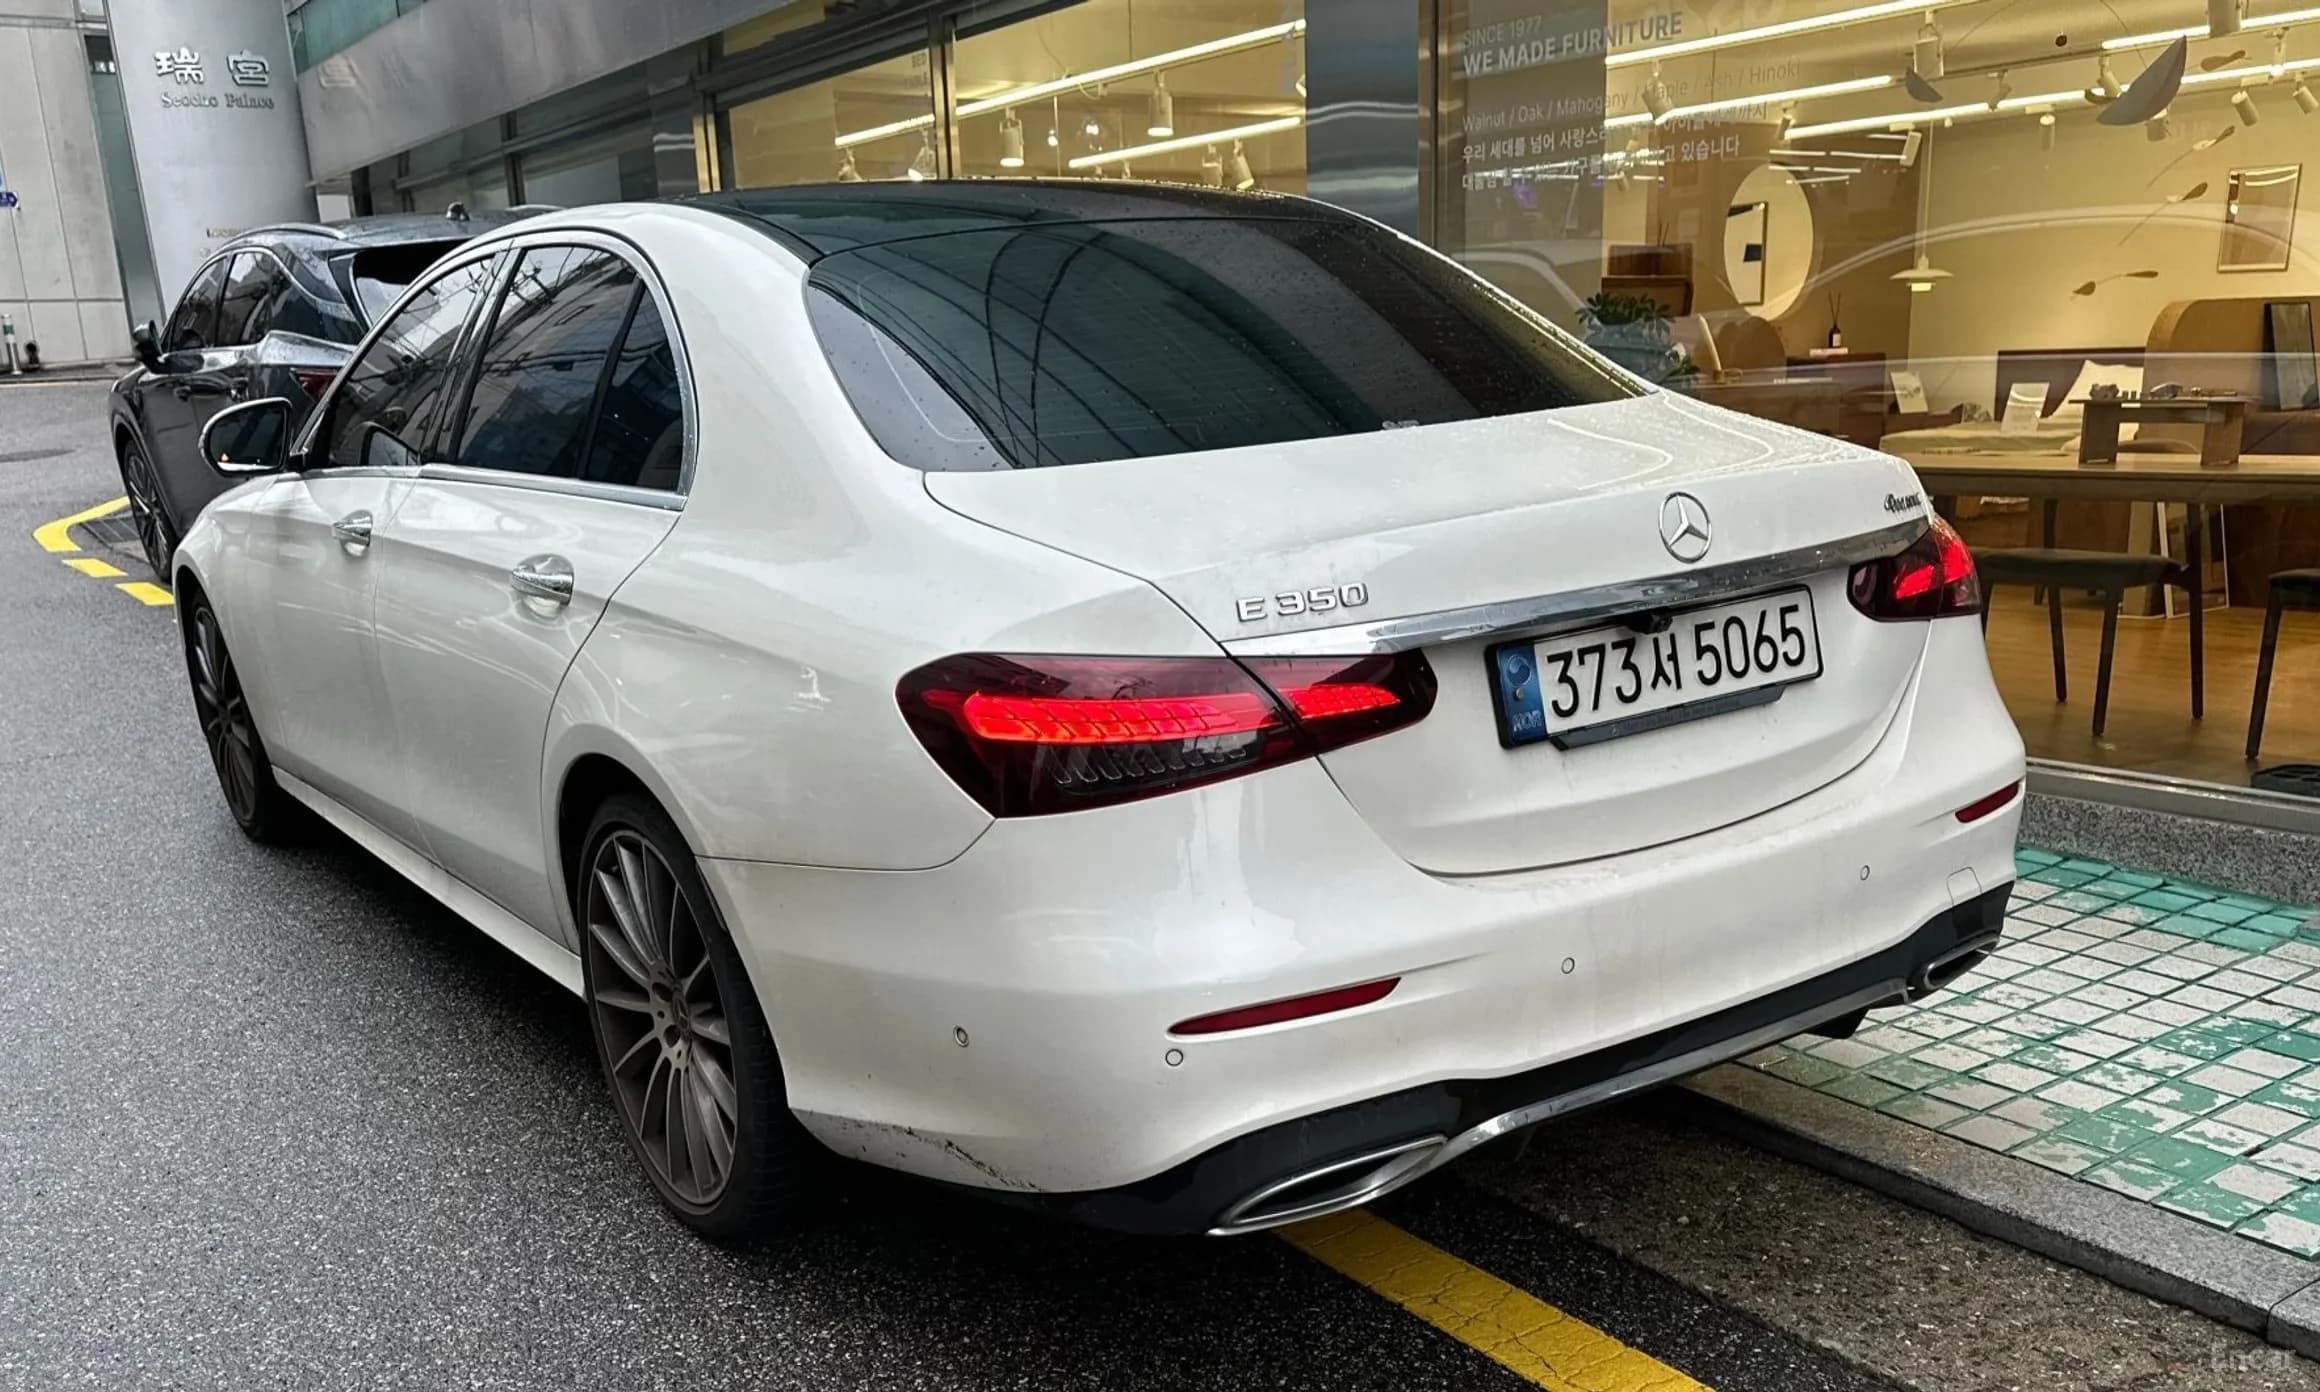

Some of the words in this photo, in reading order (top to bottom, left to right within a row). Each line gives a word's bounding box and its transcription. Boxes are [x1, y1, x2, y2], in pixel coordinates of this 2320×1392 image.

[1463, 23, 1504, 48] SINCE
[1511, 16, 1542, 38] 1977
[1463, 50, 1493, 77] WE
[1500, 39, 1555, 69] MADE
[1563, 11, 1682, 55] FURNITURE
[1463, 111, 1506, 132] Walnut
[1518, 103, 1544, 123] Oak
[1557, 93, 1629, 115] Mahogany
[1463, 143, 1485, 164] 우리
[1490, 136, 1526, 159] 세대를
[1530, 132, 1555, 154] 넘어
[1682, 134, 1741, 161] 있습니다
[1236, 596, 1268, 622] E
[1275, 582, 1369, 617] 350
[1546, 632, 1683, 718] 373서
[1694, 604, 1806, 686] 5065
